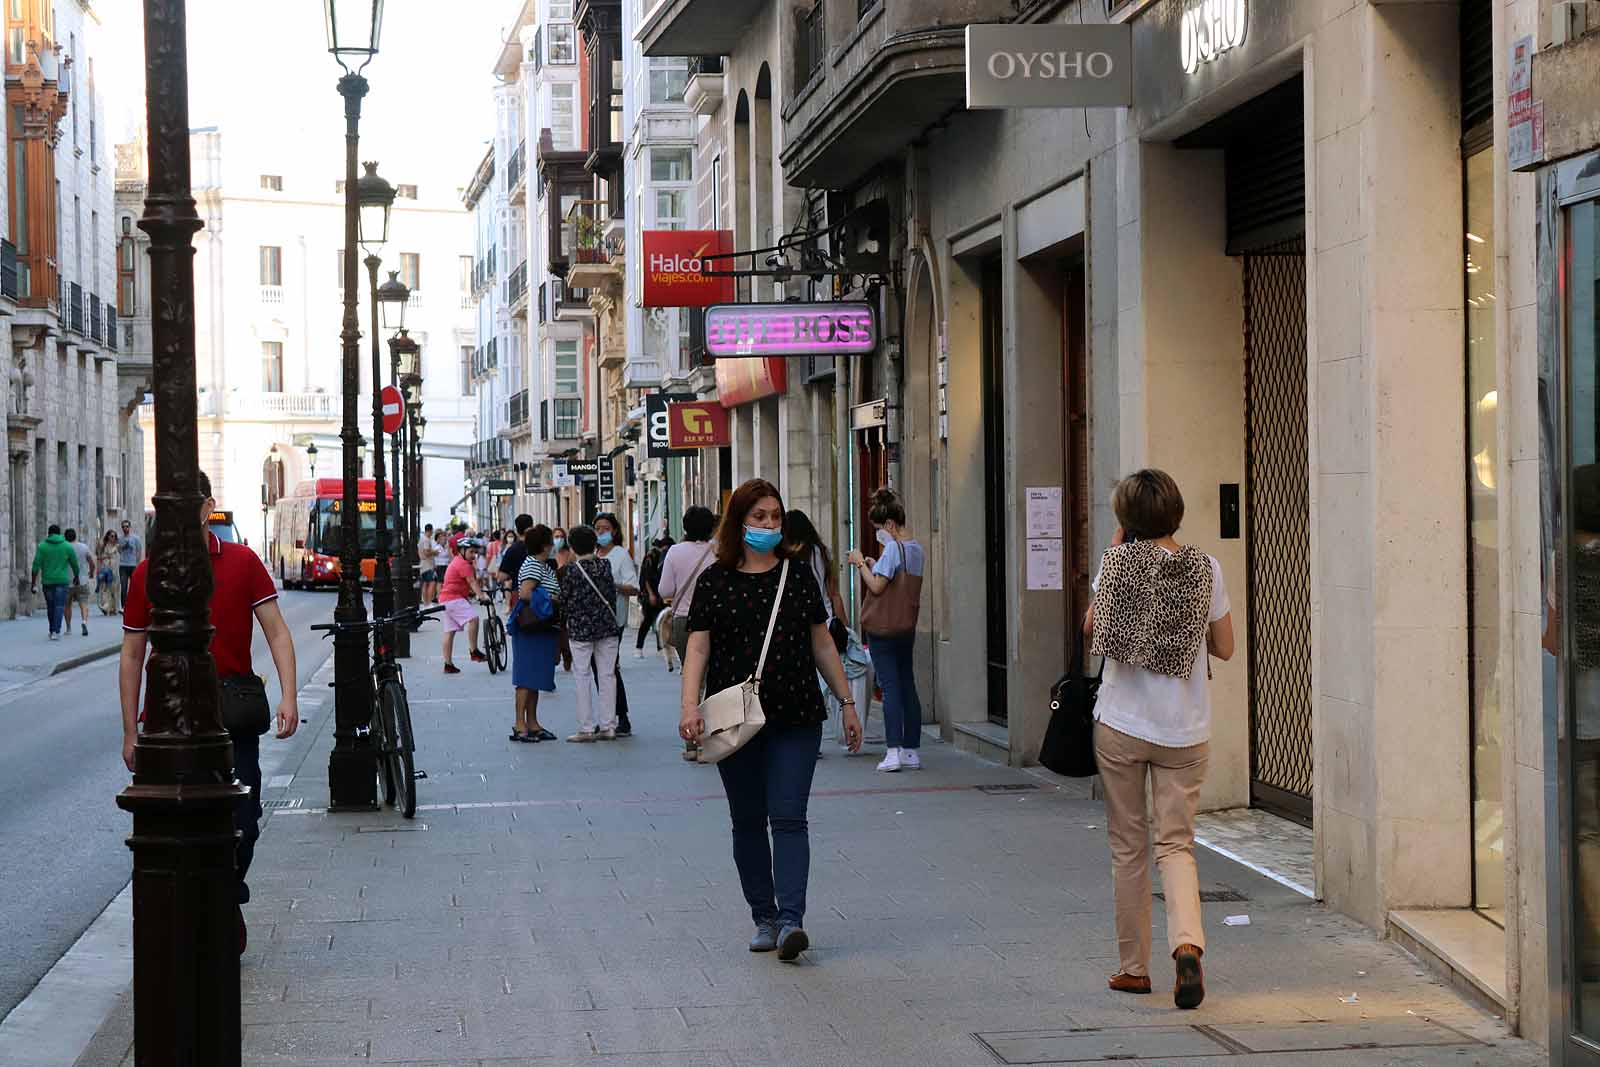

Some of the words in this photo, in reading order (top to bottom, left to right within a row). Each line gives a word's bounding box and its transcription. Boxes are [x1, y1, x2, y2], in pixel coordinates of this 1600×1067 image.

[988, 51, 1113, 79] OYSHO
[651, 272, 713, 286] viajes.com
[793, 315, 873, 344] BOSS
[570, 463, 598, 471] MANGO
[334, 500, 340, 511] 3
